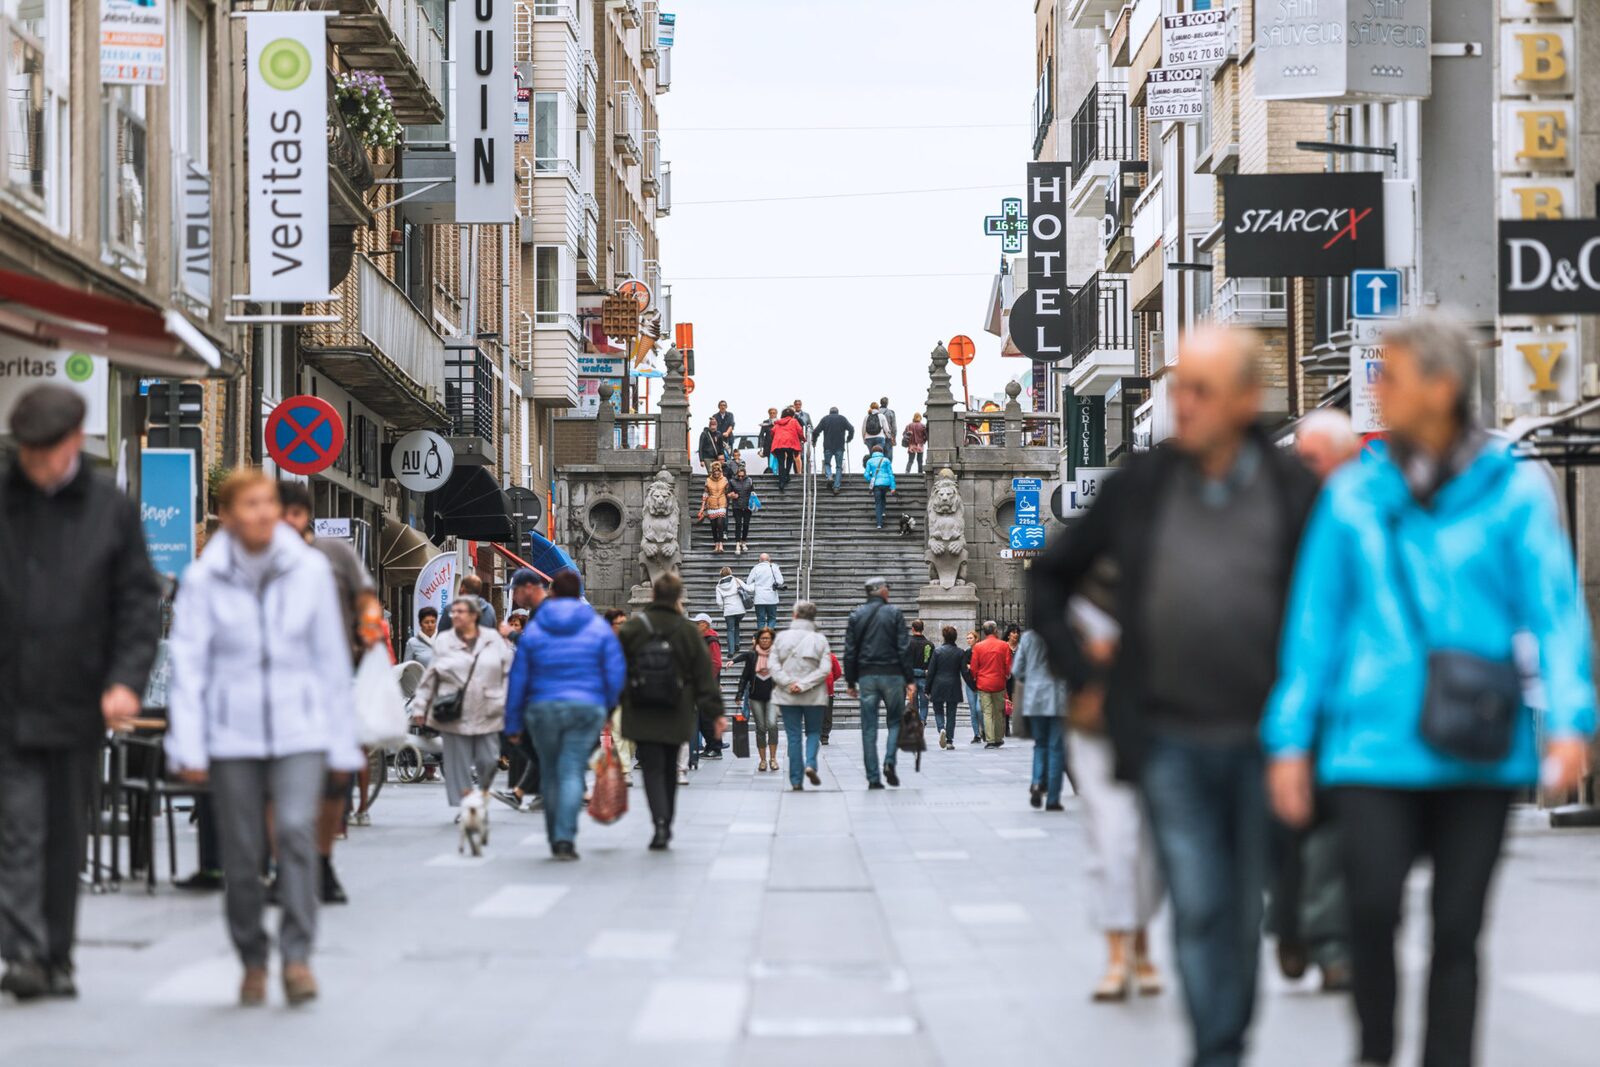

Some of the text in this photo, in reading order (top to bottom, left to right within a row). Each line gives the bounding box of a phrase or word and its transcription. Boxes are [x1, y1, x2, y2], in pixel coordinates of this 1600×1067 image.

[1168, 12, 1222, 28] TE KOOP
[1258, 22, 1344, 51] SAUVEUR
[1349, 21, 1427, 48] SAUVEUR
[1169, 52, 1185, 63] 050
[1188, 50, 1198, 60] 42
[1201, 49, 1211, 59] 70
[1214, 47, 1224, 58] 80
[1150, 69, 1201, 82] TE KOOP
[1150, 103, 1202, 115] 050 42 70 80
[262, 109, 303, 276] veritas
[1234, 207, 1373, 249] STARCKX
[1032, 176, 1062, 353] HOTEL
[582, 364, 613, 373] wafels
[1081, 406, 1090, 465] CRICKET
[402, 450, 420, 470] AU
[1082, 479, 1096, 497] DE
[419, 563, 451, 601] bruist!
